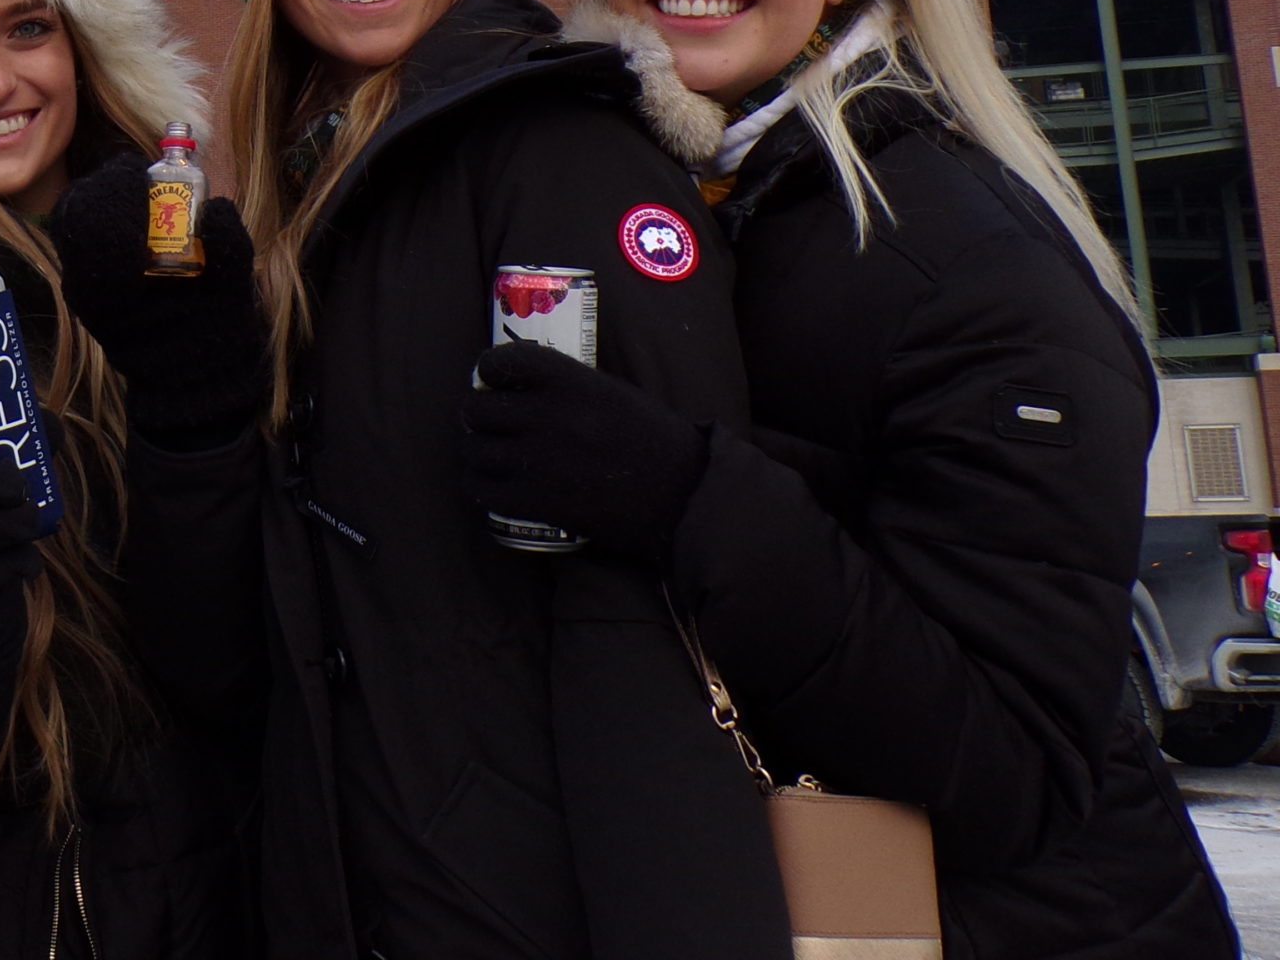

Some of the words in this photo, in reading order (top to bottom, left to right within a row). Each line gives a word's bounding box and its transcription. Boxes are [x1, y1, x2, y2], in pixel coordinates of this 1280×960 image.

[149, 185, 190, 201] FIREBALL
[635, 255, 660, 273] ARCTIC
[5, 311, 22, 367] SELTZER
[20, 374, 38, 433] ALCOHOL
[35, 439, 55, 503] PREMIUM
[308, 500, 336, 527] CANADA
[337, 522, 367, 546] GOOSE
